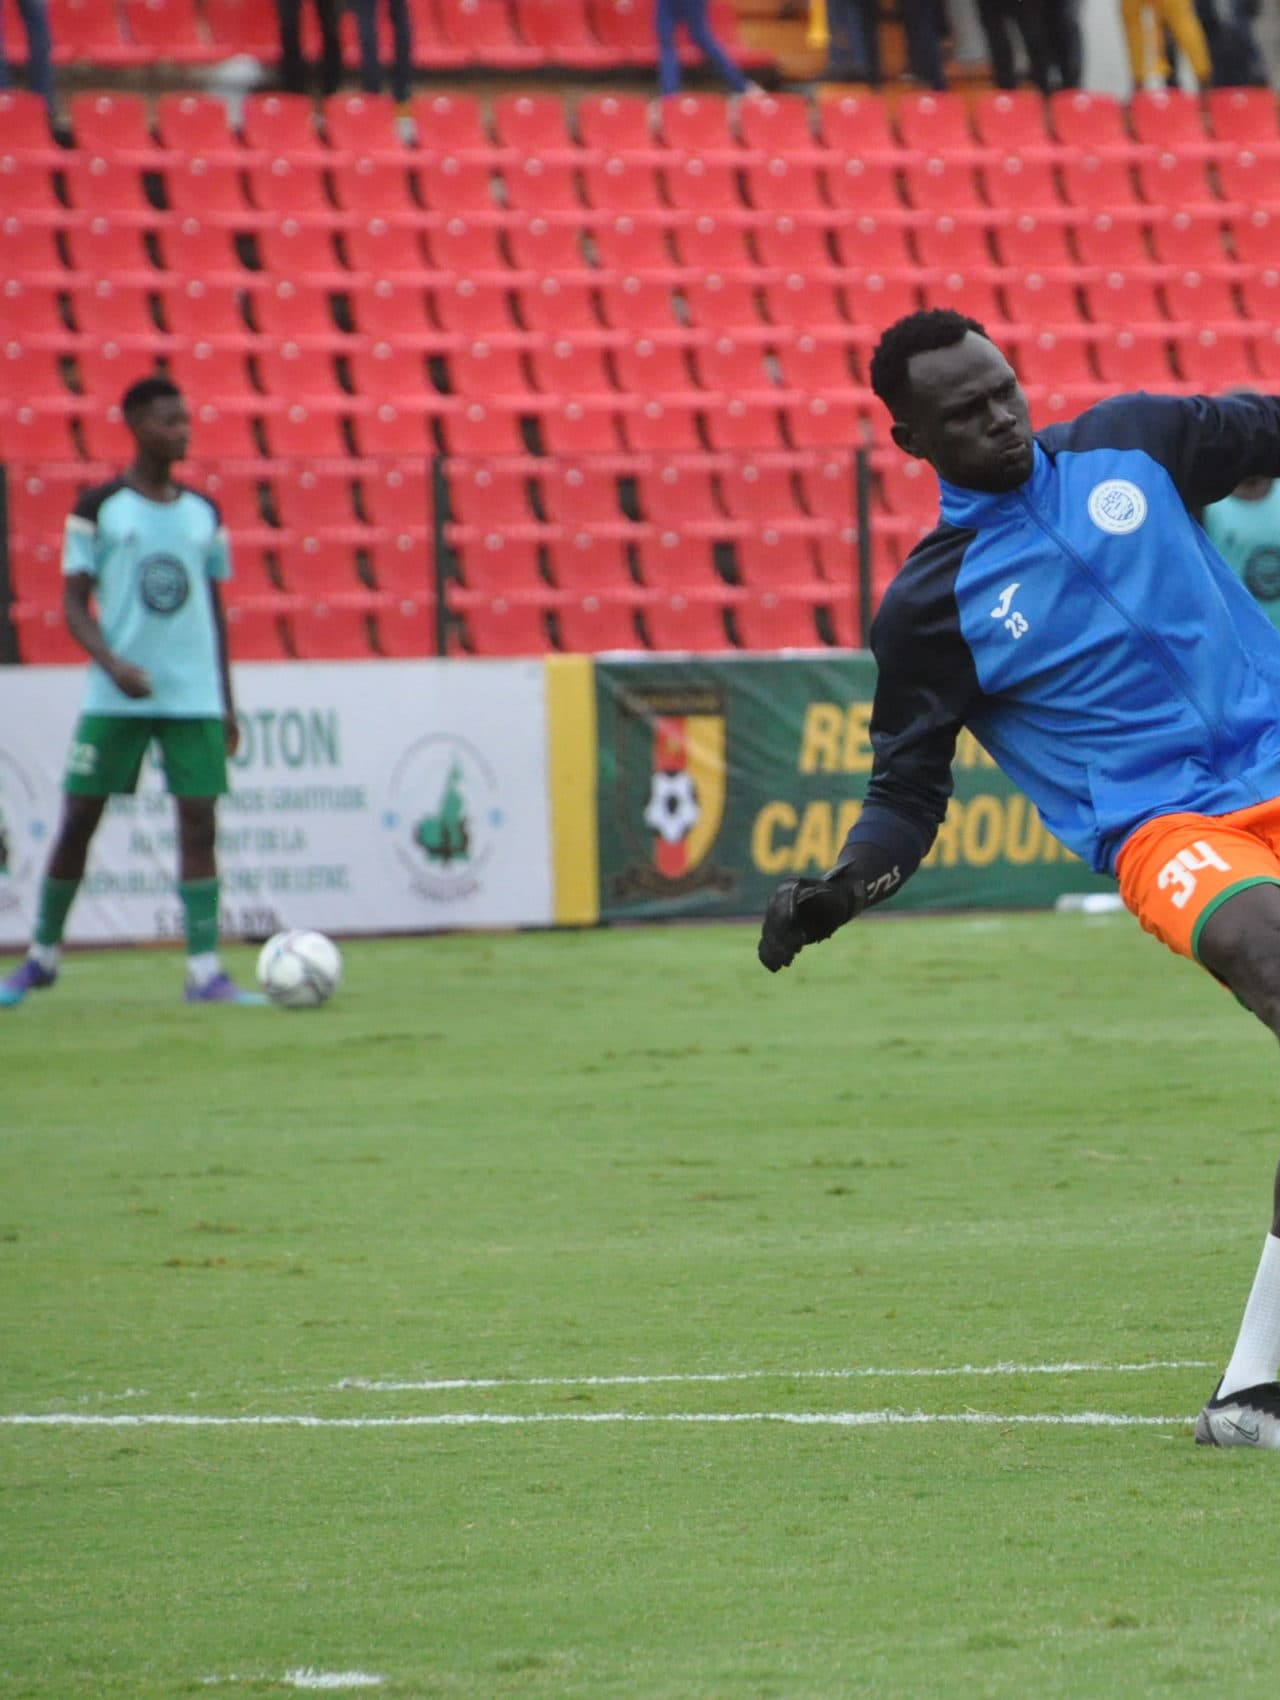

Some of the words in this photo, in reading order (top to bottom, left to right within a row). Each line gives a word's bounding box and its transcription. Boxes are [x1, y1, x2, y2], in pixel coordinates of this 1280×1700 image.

[1004, 611, 1029, 639] 23
[231, 709, 339, 768] OTON
[1157, 841, 1231, 909] 34
